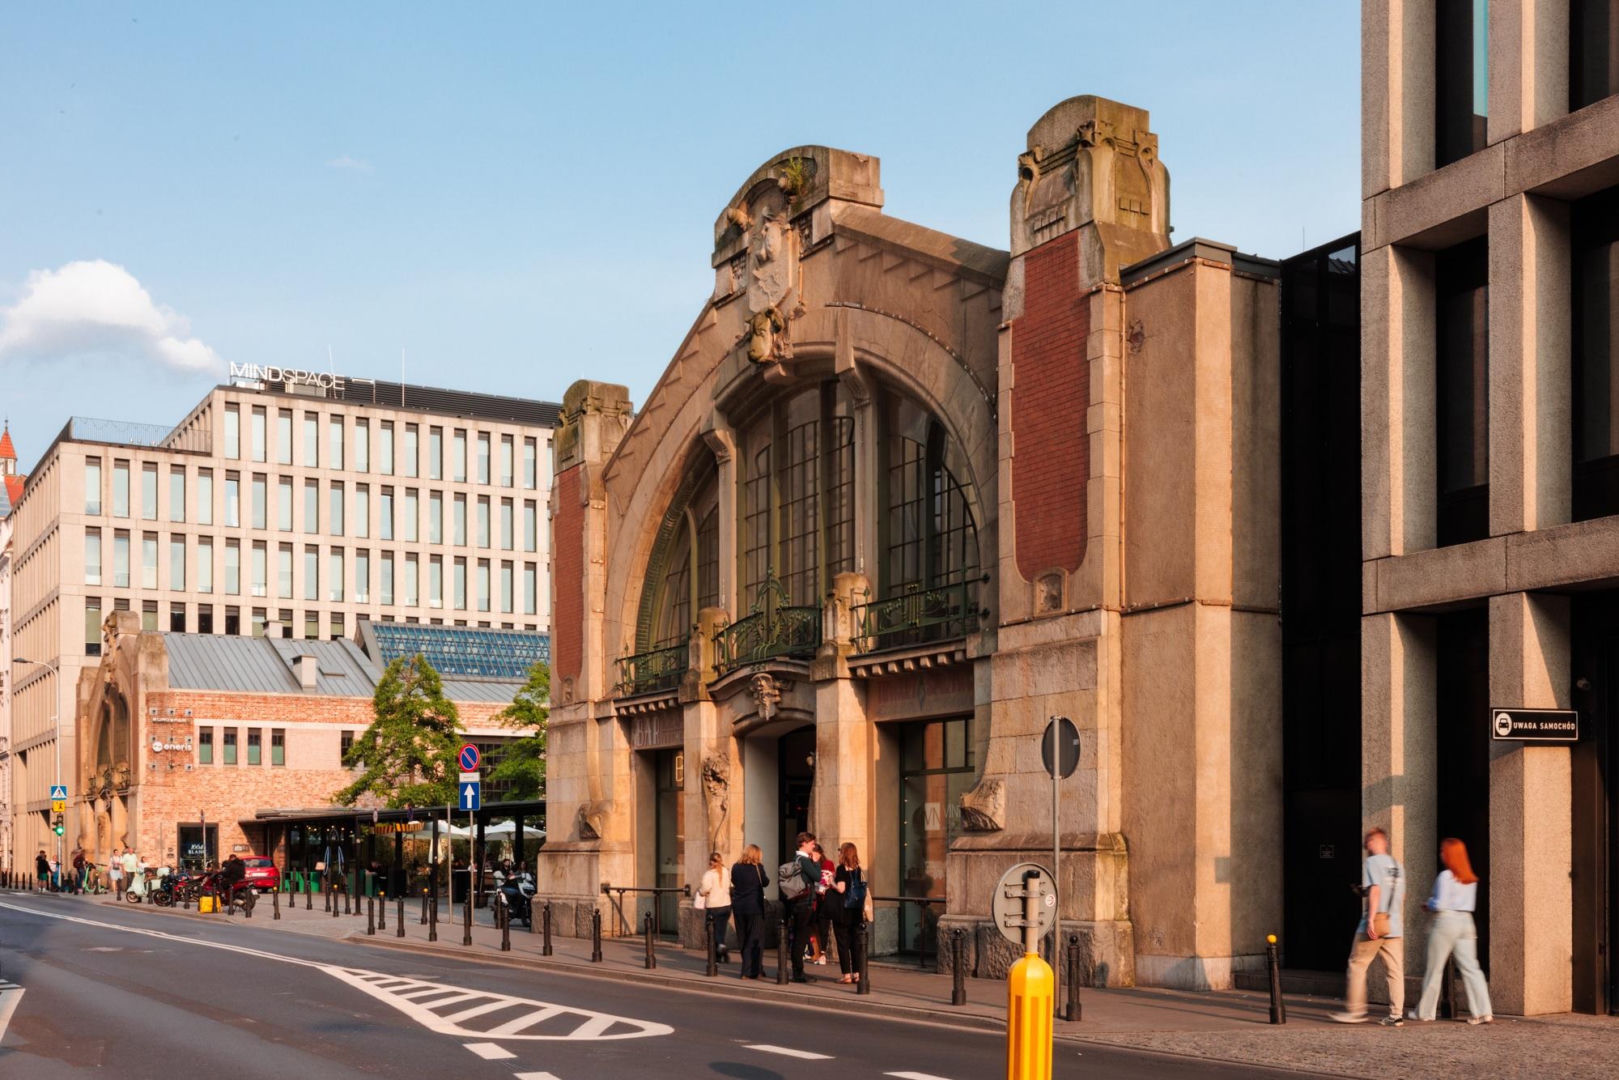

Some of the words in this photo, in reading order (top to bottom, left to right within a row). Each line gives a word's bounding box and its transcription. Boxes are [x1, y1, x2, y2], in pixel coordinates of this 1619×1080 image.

[230, 361, 345, 391] MINDSPACE
[1540, 721, 1575, 730] SAMOCHÓD
[163, 743, 192, 751] eneris
